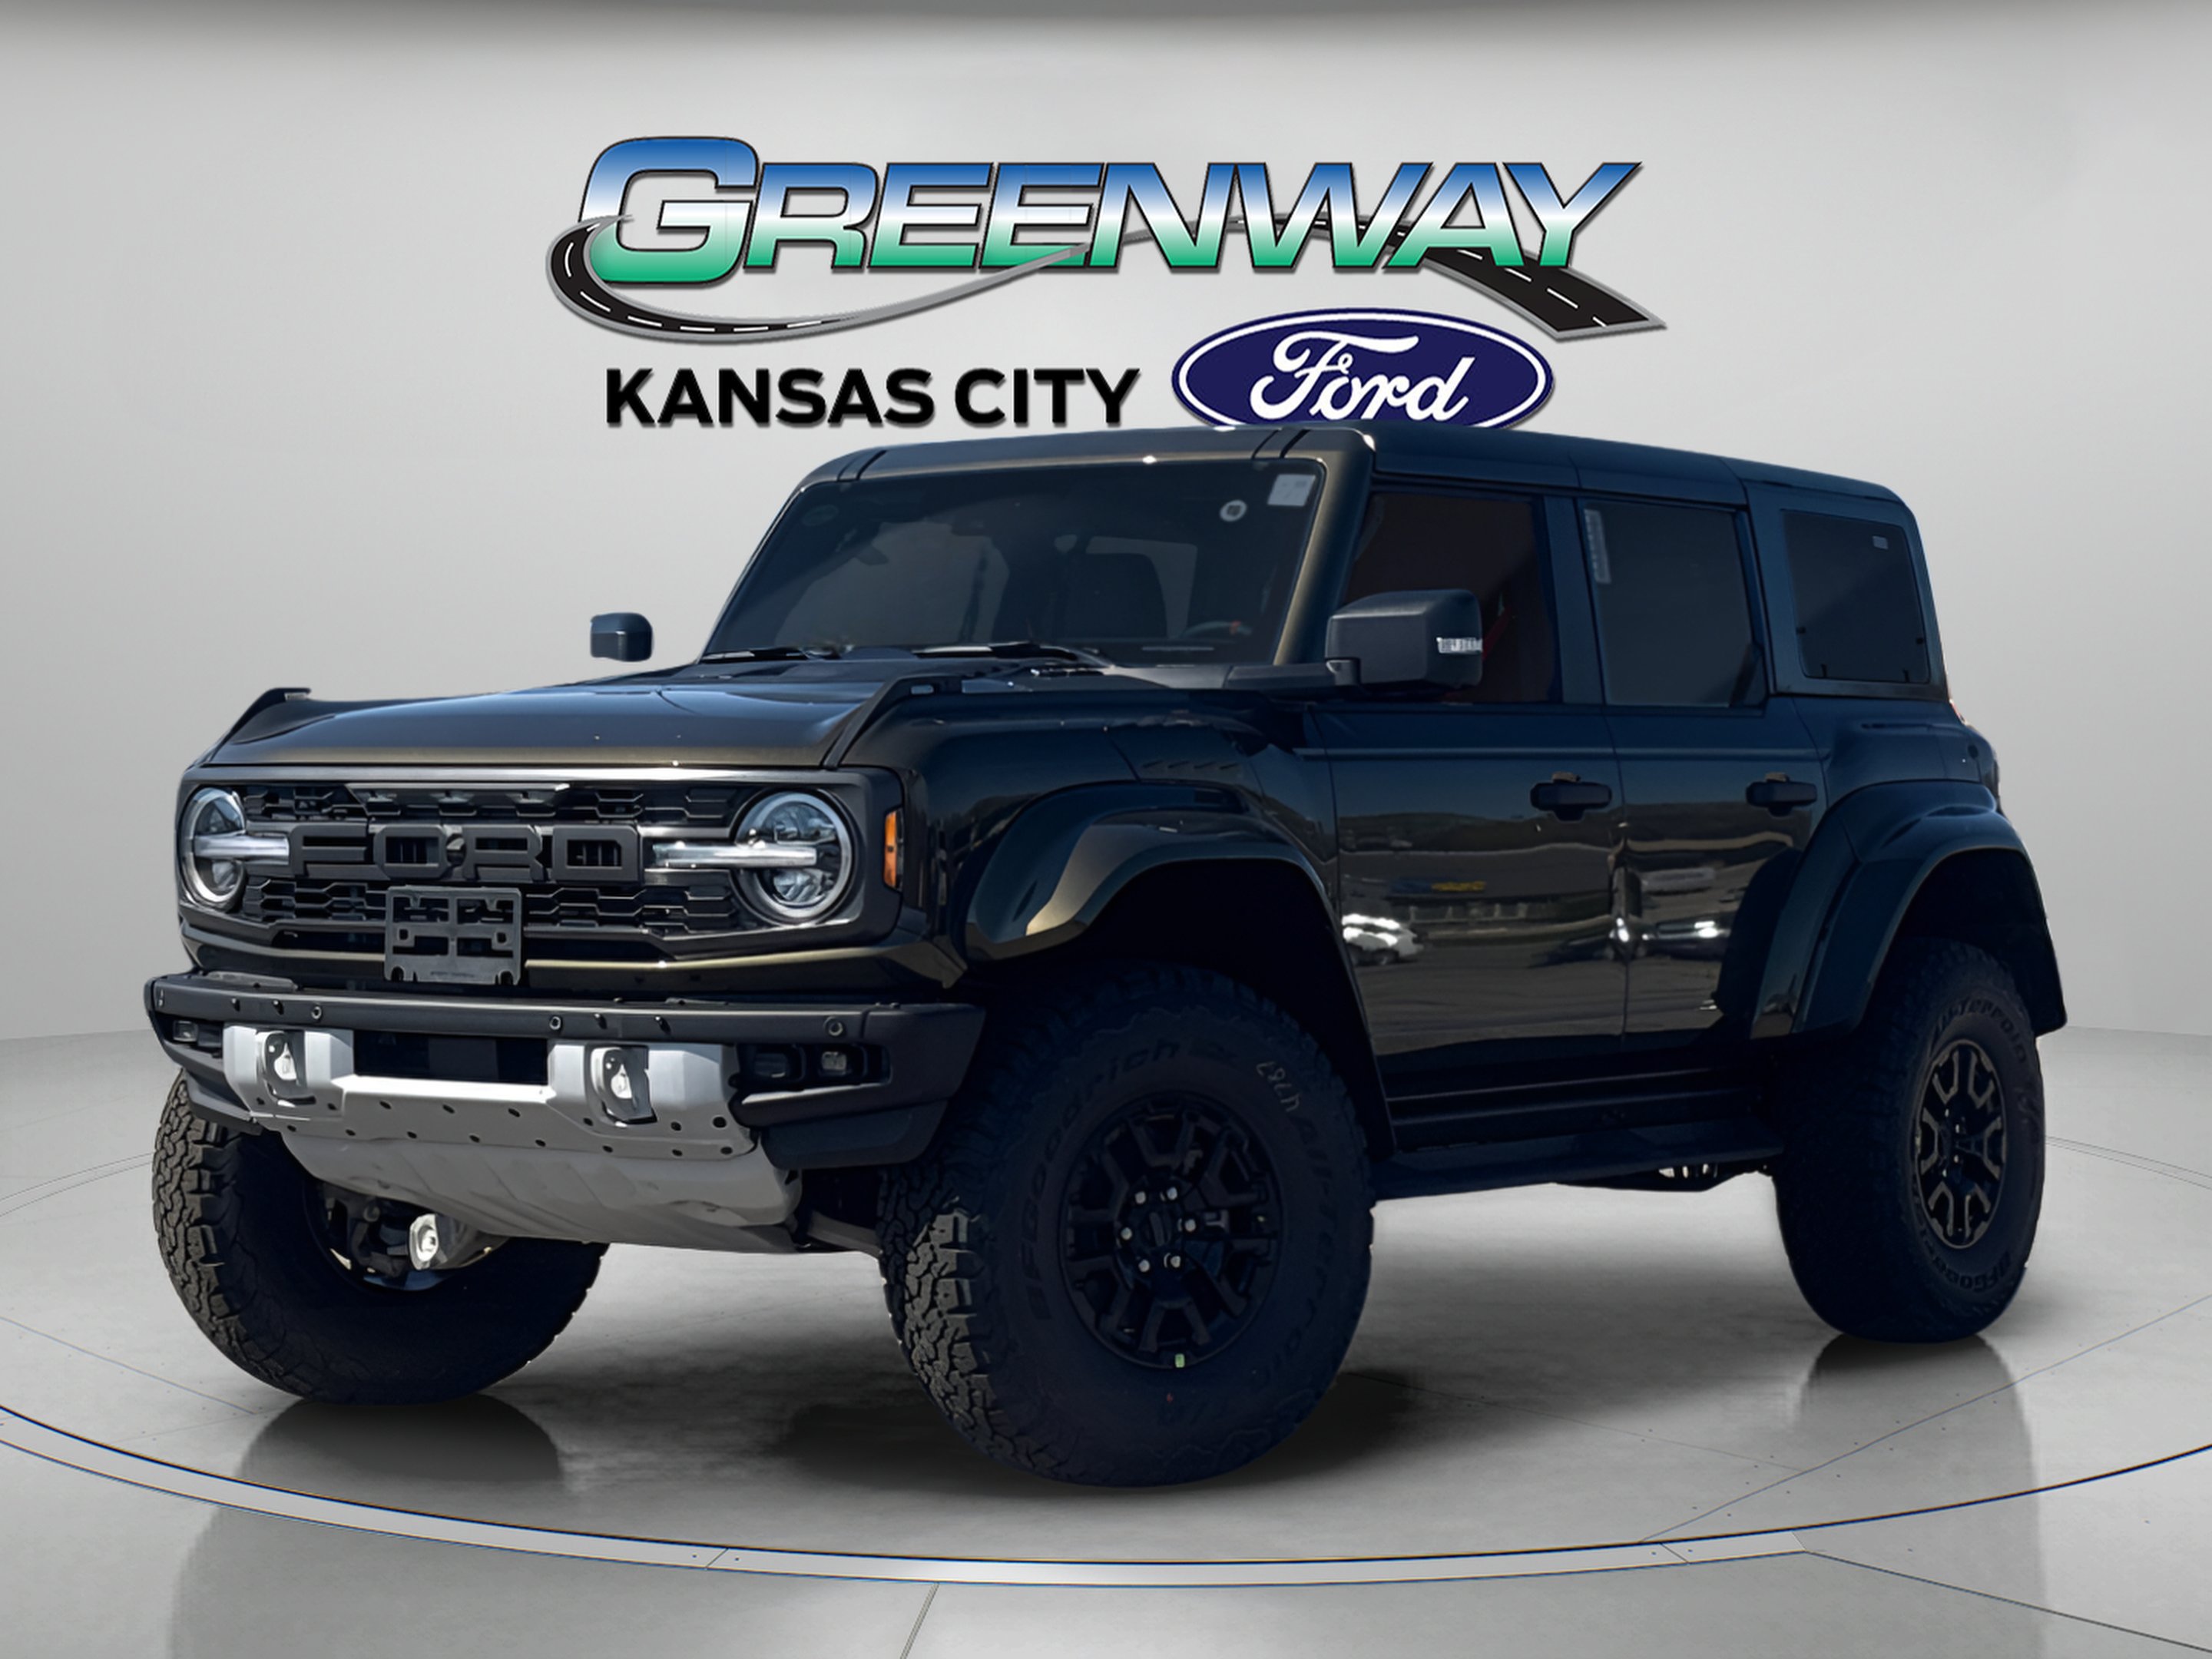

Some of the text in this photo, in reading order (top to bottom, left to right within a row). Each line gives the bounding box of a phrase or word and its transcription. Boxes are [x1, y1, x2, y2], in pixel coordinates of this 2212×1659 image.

[579, 136, 1641, 284] GREENWAY
[606, 331, 1475, 426] KANSAS CITY Ford
[290, 825, 641, 882] FORD
